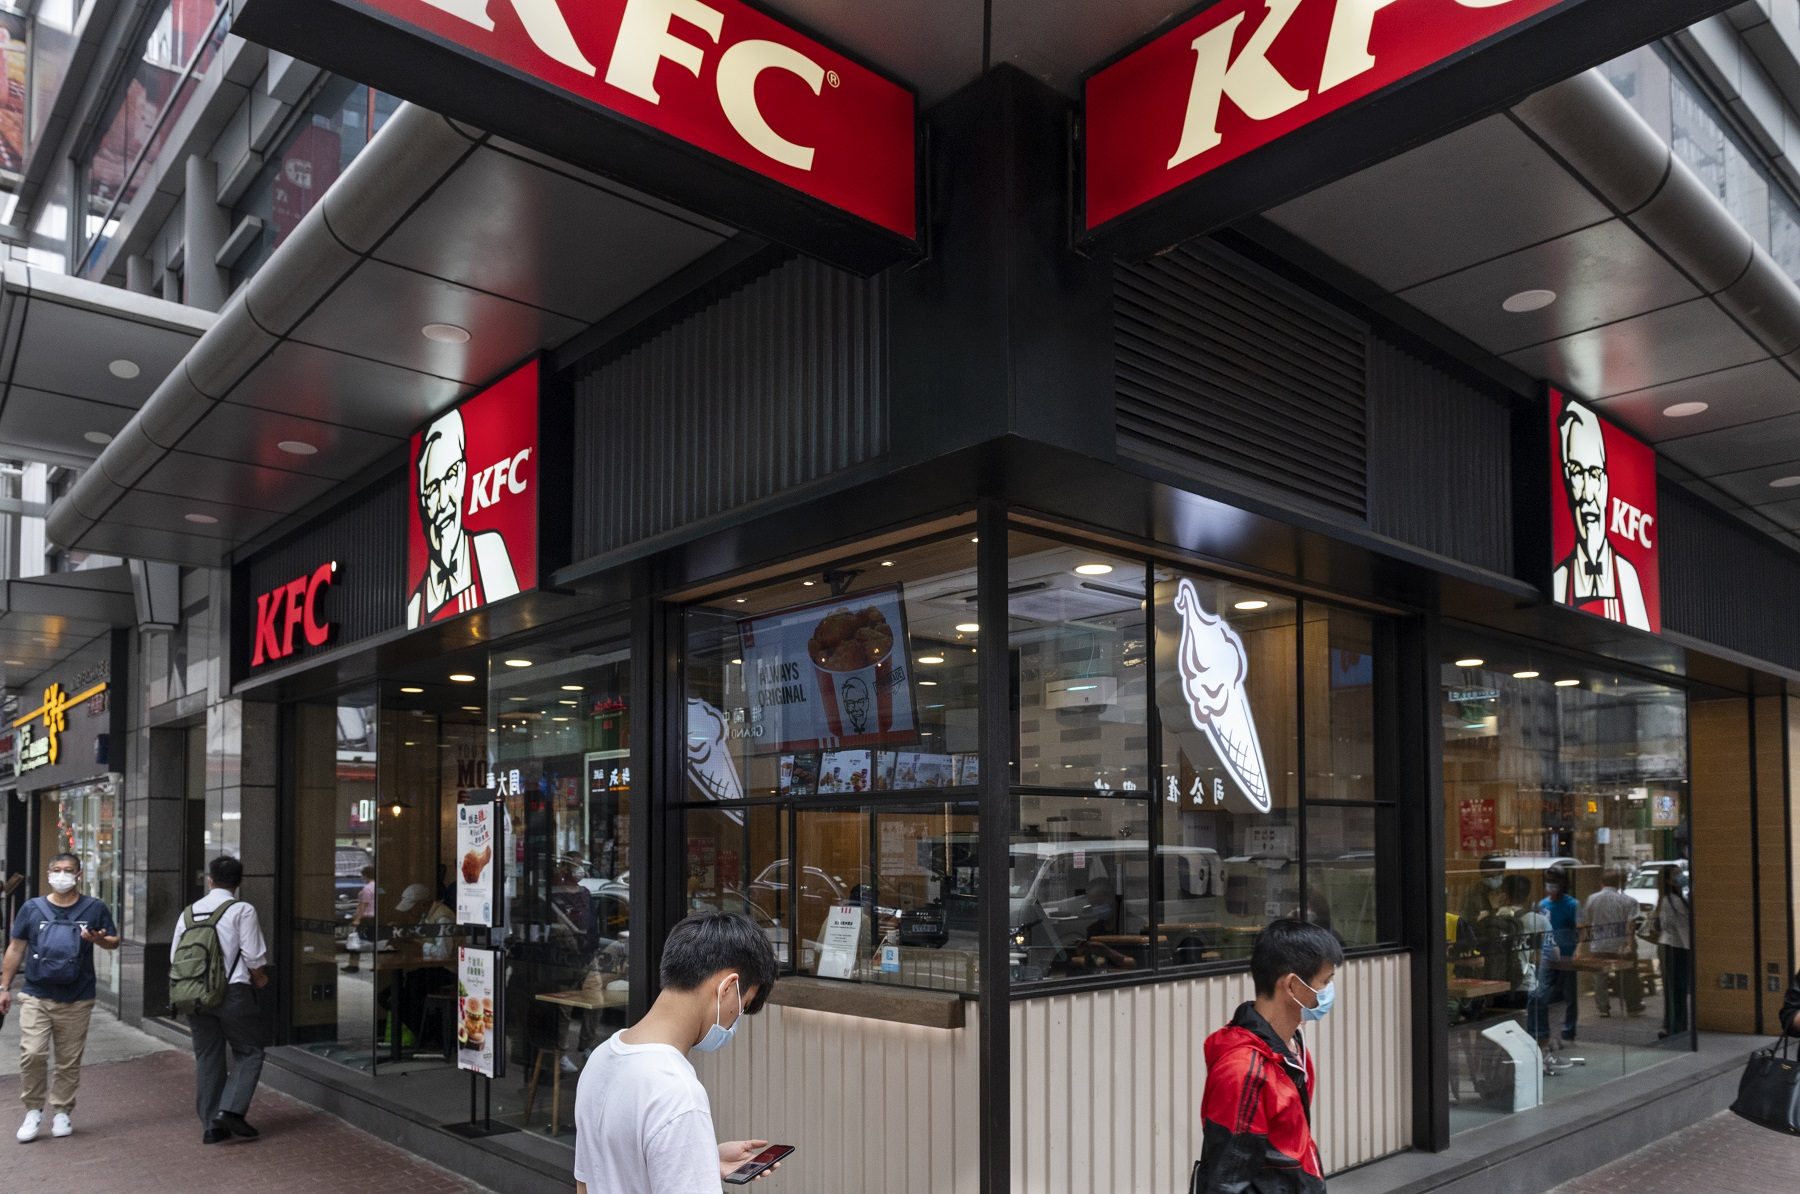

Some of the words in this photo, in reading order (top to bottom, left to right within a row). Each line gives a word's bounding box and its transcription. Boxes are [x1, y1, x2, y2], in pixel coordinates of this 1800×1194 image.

[468, 448, 530, 516] KFC
[1610, 496, 1653, 549] KFC
[252, 562, 333, 667] KFC
[757, 684, 807, 708] ORIGINAL
[758, 661, 800, 686] ALWAYS
